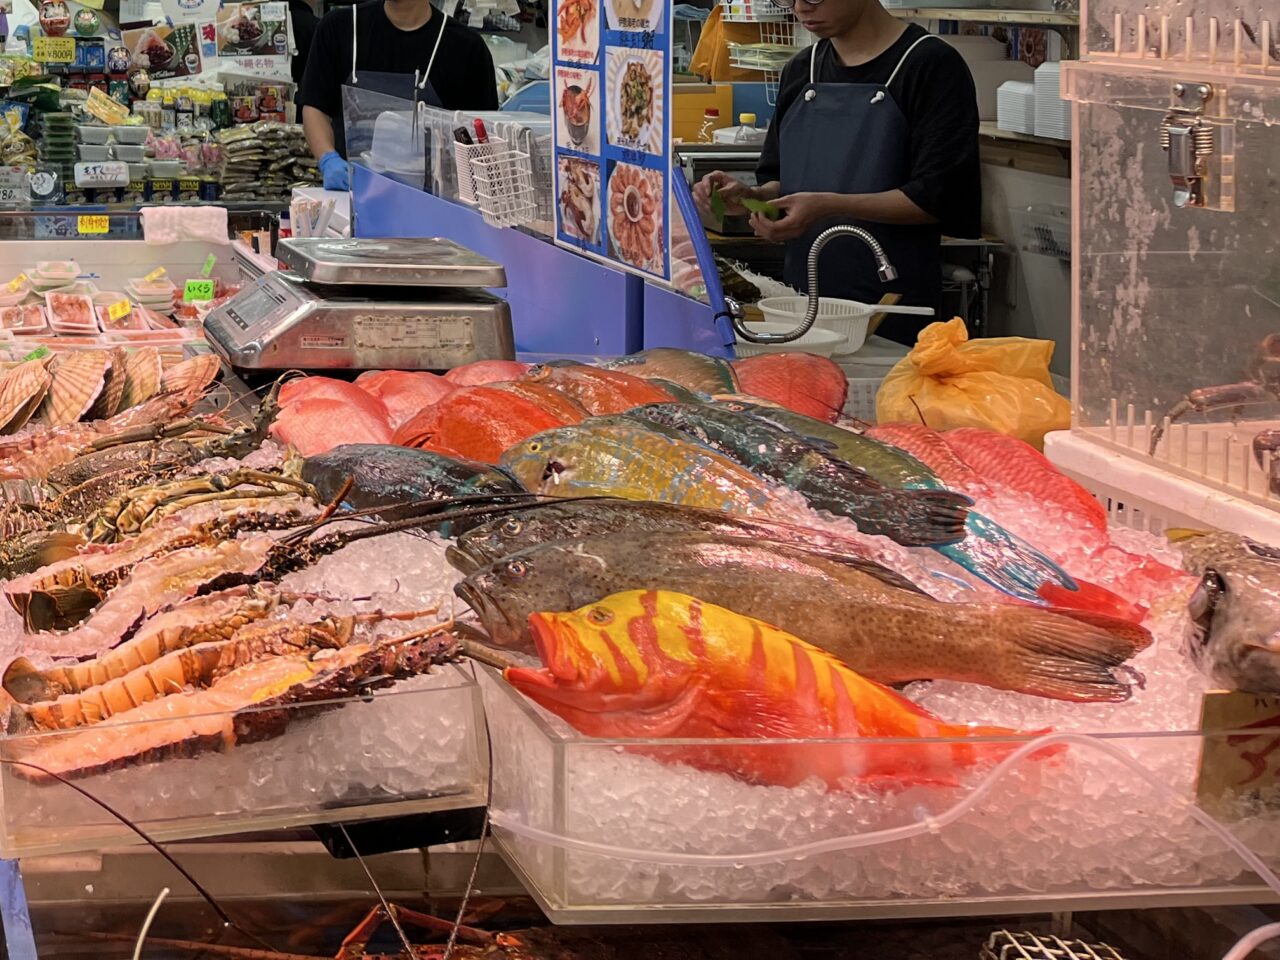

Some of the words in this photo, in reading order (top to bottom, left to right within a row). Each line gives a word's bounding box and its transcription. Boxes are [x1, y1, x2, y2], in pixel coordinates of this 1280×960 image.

[152, 181, 173, 191] SPAM
[179, 180, 199, 191] SPAM
[187, 284, 212, 295] いくら
